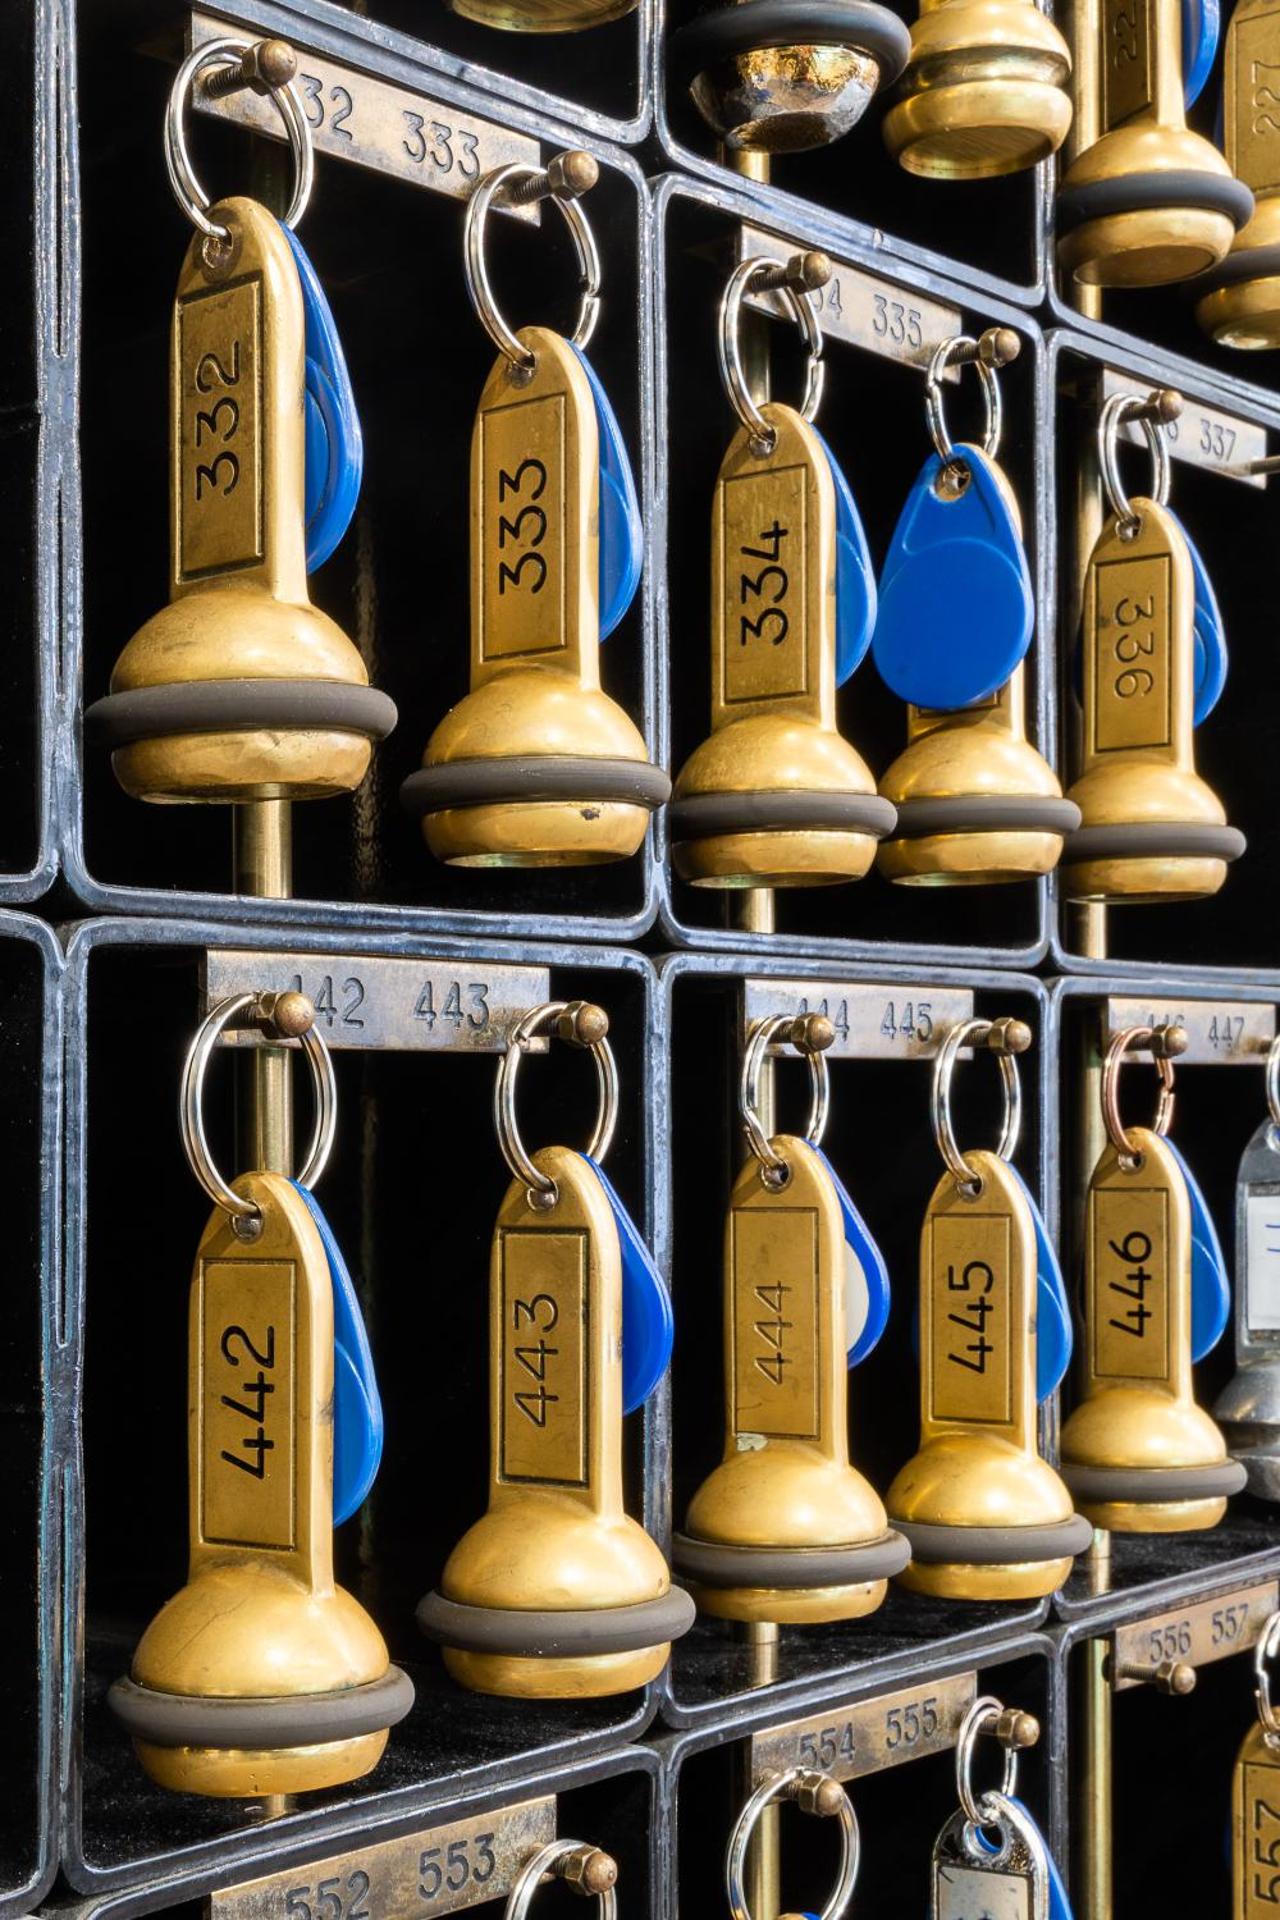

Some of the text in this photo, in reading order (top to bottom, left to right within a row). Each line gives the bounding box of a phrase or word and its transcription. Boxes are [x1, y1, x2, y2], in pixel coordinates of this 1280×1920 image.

[299, 73, 480, 181] 32 333
[872, 293, 922, 348] 335
[196, 341, 241, 500] 332
[1200, 418, 1236, 462] 337
[499, 458, 548, 595] 333
[741, 521, 789, 646] 334
[1115, 596, 1153, 698] 336
[412, 980, 489, 1031] 443
[880, 1001, 933, 1042] 445
[1208, 1015, 1245, 1049] 447
[754, 1280, 793, 1386] 444
[948, 1261, 994, 1374] 445
[1109, 1231, 1152, 1338] 446
[221, 1325, 274, 1478] 442
[513, 1293, 559, 1428] 443
[1150, 1603, 1249, 1663] 556 557
[799, 1697, 938, 1770] 554 555
[285, 1832, 496, 1920] 552 553
